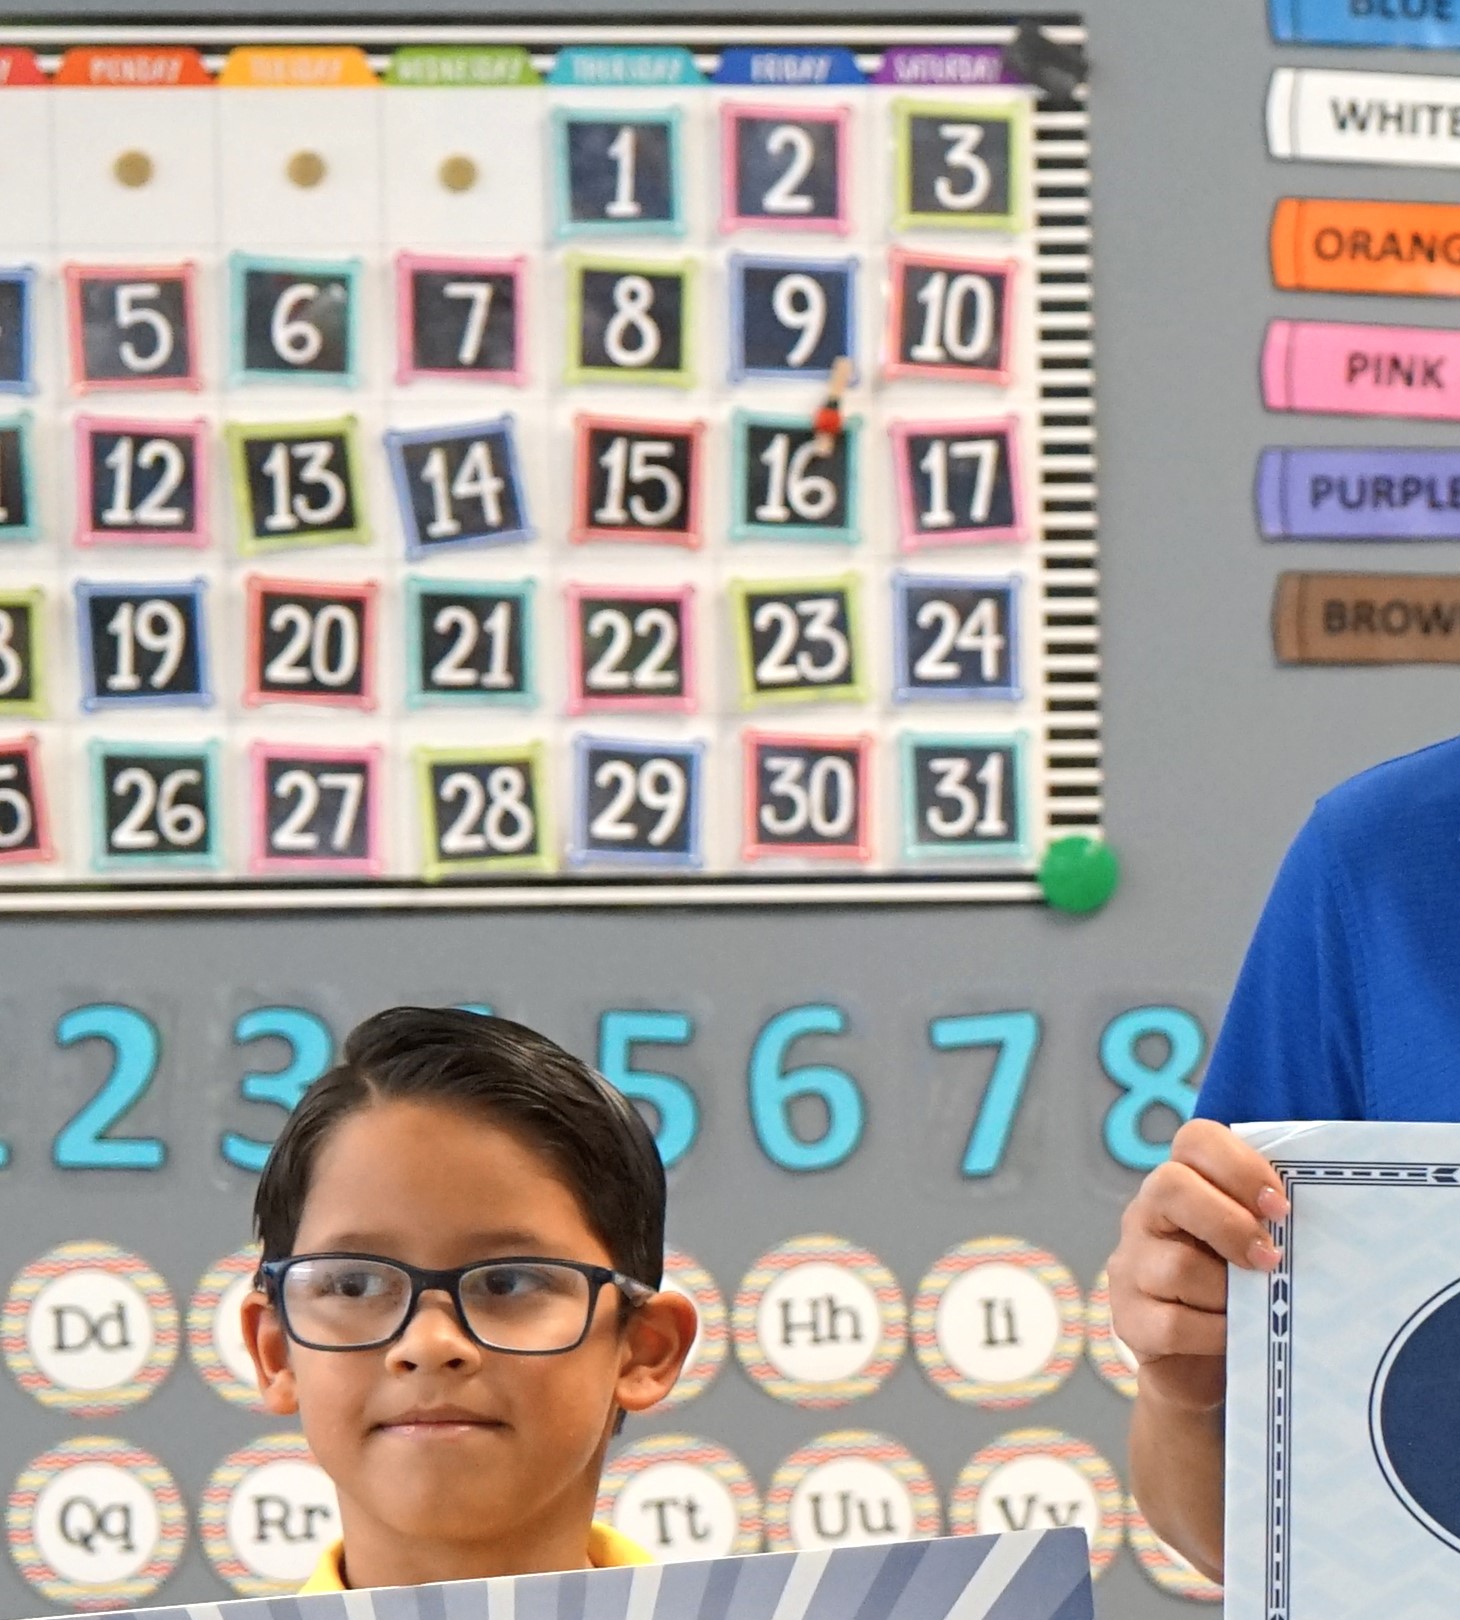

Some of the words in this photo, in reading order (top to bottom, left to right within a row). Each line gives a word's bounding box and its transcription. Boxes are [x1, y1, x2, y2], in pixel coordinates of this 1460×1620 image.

[750, 53, 833, 83] FRIDAY
[604, 125, 642, 218] 1
[763, 125, 815, 212] 2
[933, 123, 991, 209] 3
[114, 283, 174, 371] 5
[271, 283, 324, 364] 6
[443, 282, 493, 366] 7
[604, 275, 660, 366] 8
[772, 273, 827, 367] 9
[910, 271, 995, 362] 10
[1345, 350, 1446, 391] PINK
[102, 436, 185, 526] 12
[264, 440, 347, 531] 13
[421, 440, 504, 538] 14
[595, 437, 682, 526] 15
[755, 434, 838, 523] 16
[920, 438, 999, 528] 17
[106, 599, 187, 692] 19
[265, 604, 360, 687] 20
[431, 601, 515, 689] 21
[585, 608, 679, 689] 22
[753, 599, 850, 684] 23
[914, 598, 1005, 682] 24
[110, 767, 206, 850] 26
[271, 770, 365, 853] 27
[439, 766, 535, 855] 28
[591, 758, 687, 847] 29
[760, 755, 856, 838] 30
[927, 752, 1008, 838] 31
[53, 1001, 165, 1170] 2
[221, 1004, 333, 1172] 3
[599, 1009, 697, 1170] 5
[749, 1002, 866, 1173] 6
[929, 1009, 1040, 1178] 7
[1099, 1003, 1206, 1173] 8
[48, 1300, 131, 1354] Dd
[776, 1293, 864, 1347] Hh
[980, 1297, 1020, 1348] Ii
[57, 1494, 137, 1554] Qq
[251, 1493, 332, 1545] Rr
[641, 1496, 712, 1546] Tt
[808, 1490, 899, 1541] Uu
[994, 1492, 1085, 1533] Vv
